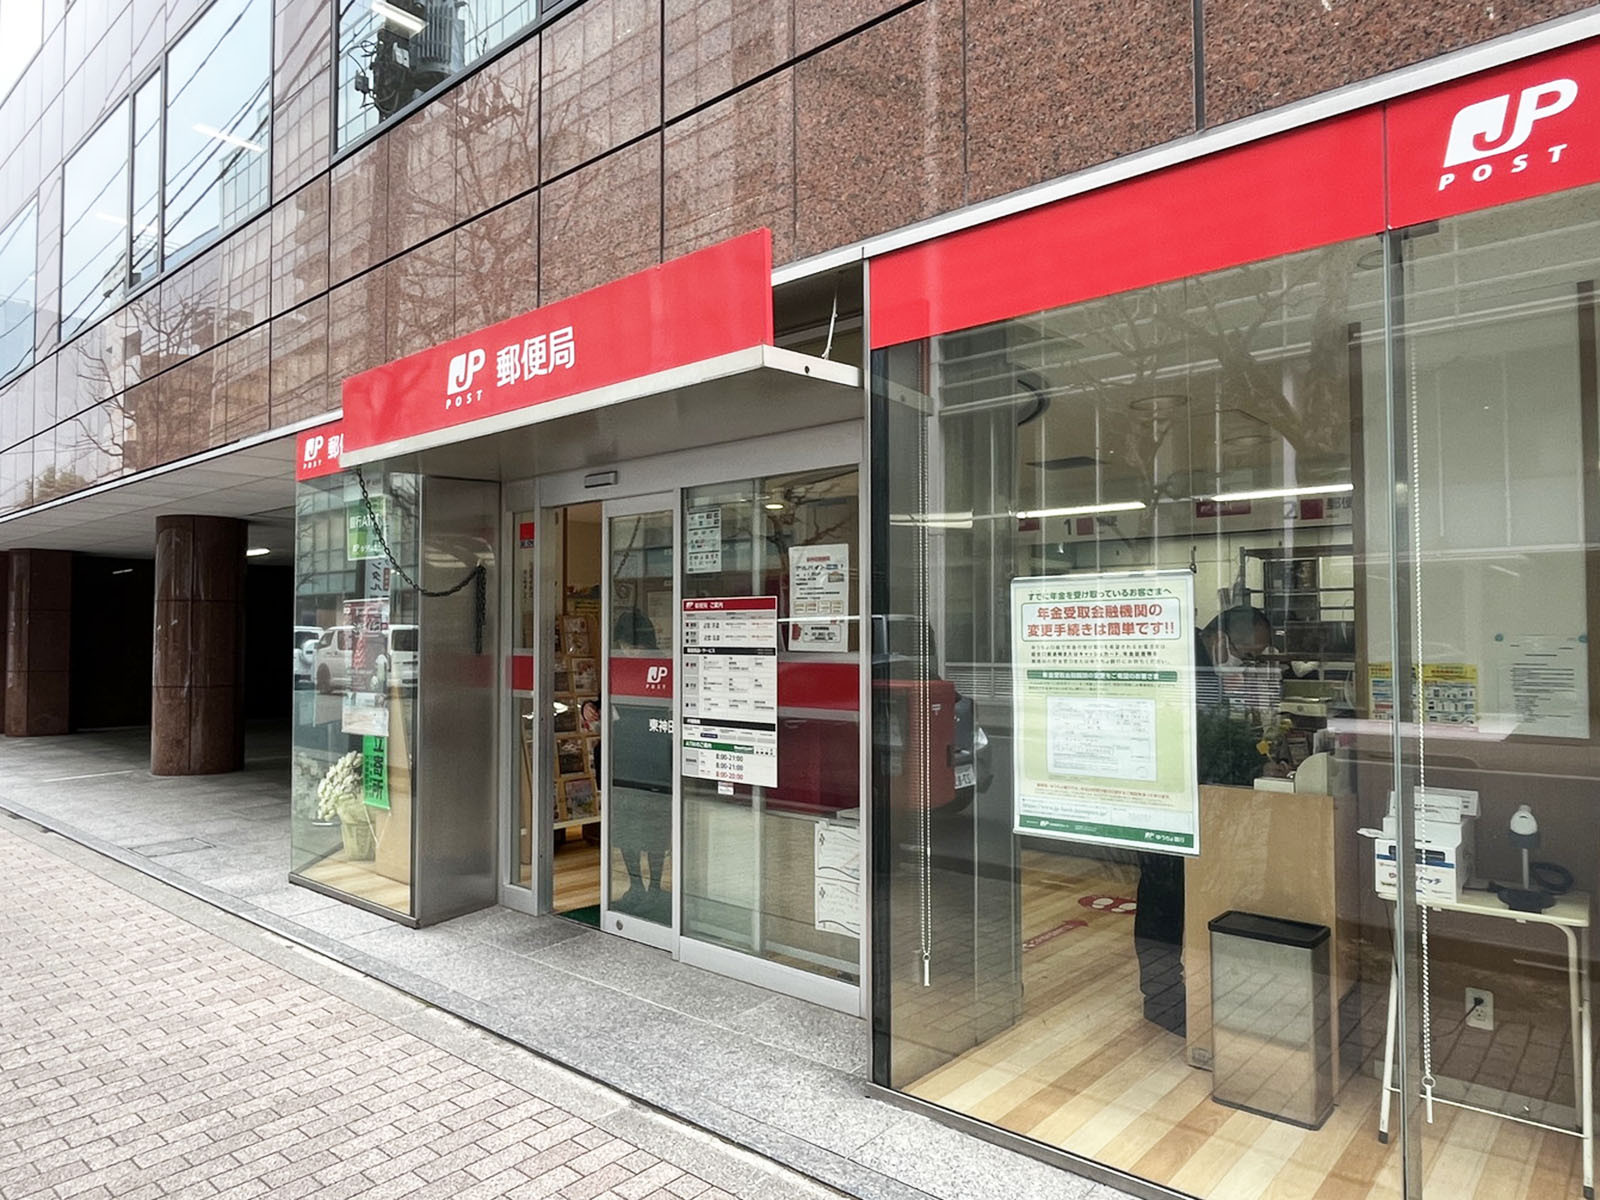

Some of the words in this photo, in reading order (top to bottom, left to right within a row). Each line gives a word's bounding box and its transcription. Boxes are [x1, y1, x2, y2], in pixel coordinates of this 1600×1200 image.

[1443, 78, 1578, 168] JP
[1438, 143, 1568, 191] POST
[496, 326, 576, 388] 郵便局
[445, 389, 484, 410] POST
[302, 459, 322, 470] POST
[1028, 587, 1172, 601] すでに年金を受け取っているお客さまへ
[1037, 603, 1163, 621] 年金受取金融機関の
[1027, 621, 1175, 637] 変更手続きは簡単です!!
